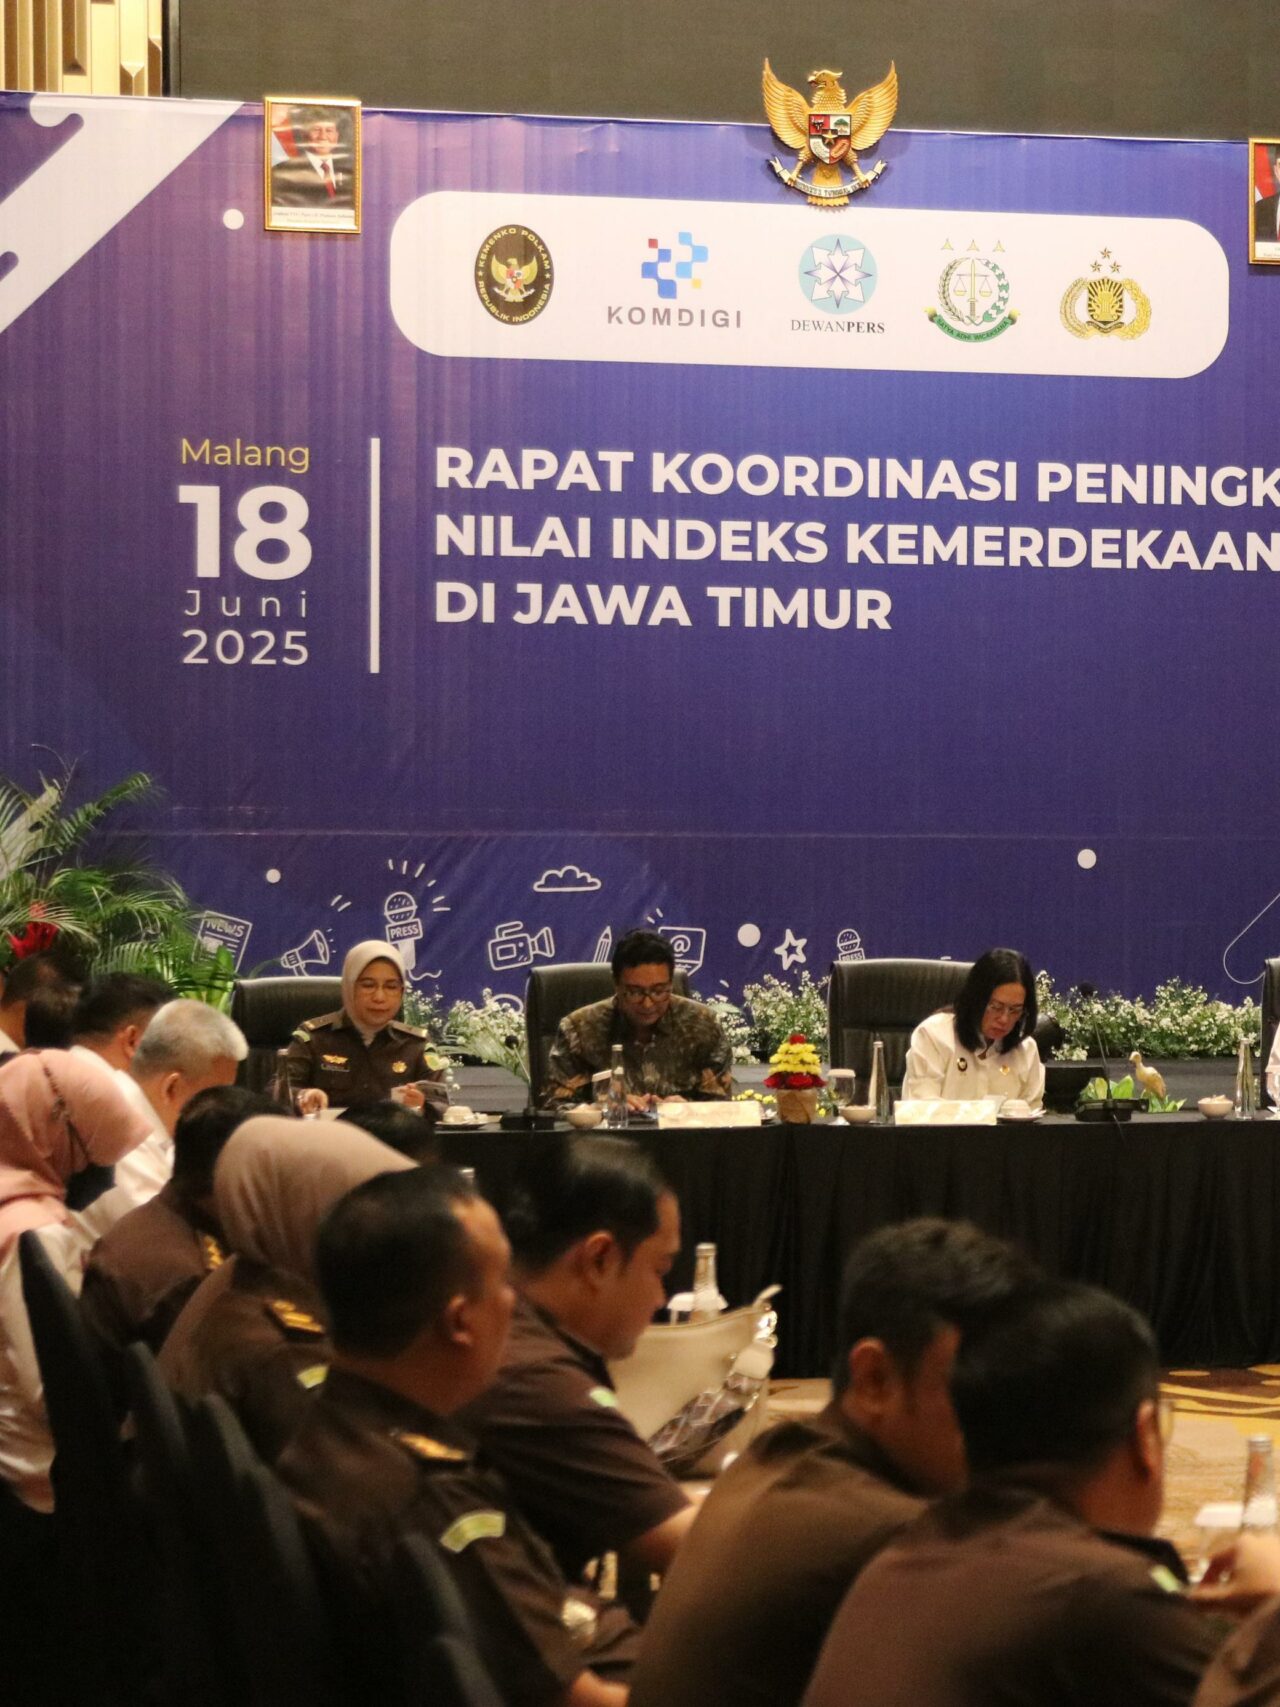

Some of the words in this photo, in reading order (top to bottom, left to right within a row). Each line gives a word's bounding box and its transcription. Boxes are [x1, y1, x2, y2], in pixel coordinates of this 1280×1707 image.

[478, 227, 518, 267] KEMENKO
[521, 229, 551, 270] POLKAM
[478, 280, 511, 321] REPUBLIK
[512, 283, 551, 323] INDONESIA
[607, 305, 742, 329] KOMDIGI
[791, 319, 886, 334] DEWANPERS
[181, 437, 310, 474] Malang
[437, 446, 635, 492] RAPAT
[653, 452, 1017, 503] KOORDINASI
[179, 485, 312, 581] 18
[436, 514, 591, 558] NILAI
[612, 517, 829, 564] INDEKS
[184, 589, 308, 618] Juni
[436, 581, 495, 624] DI
[512, 582, 693, 627] JAWA
[706, 586, 892, 630] TIMUR
[182, 628, 310, 666] 2025
[390, 924, 419, 939] PRESS
